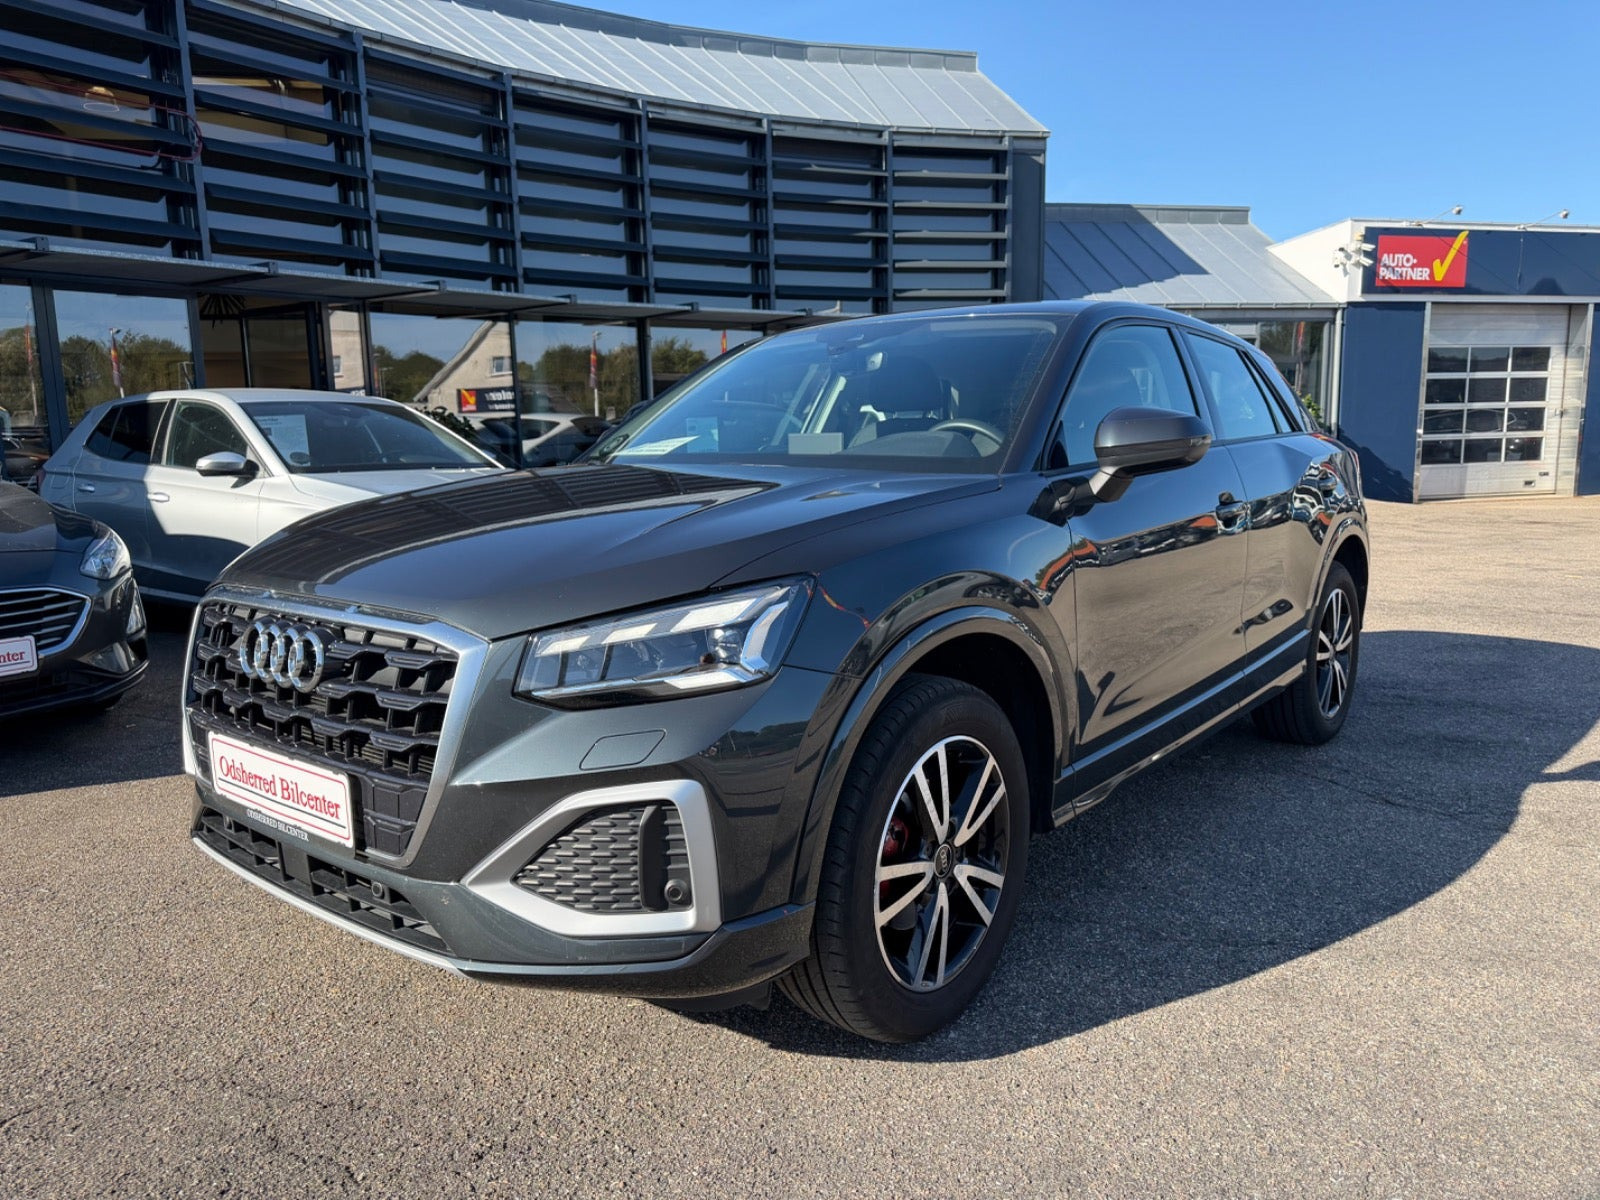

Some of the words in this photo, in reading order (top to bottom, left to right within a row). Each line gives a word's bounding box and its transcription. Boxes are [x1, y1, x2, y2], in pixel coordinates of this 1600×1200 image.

[1379, 267, 1430, 280] PARTNER
[219, 755, 277, 797] Odsherred
[279, 777, 341, 820] Bilcenter
